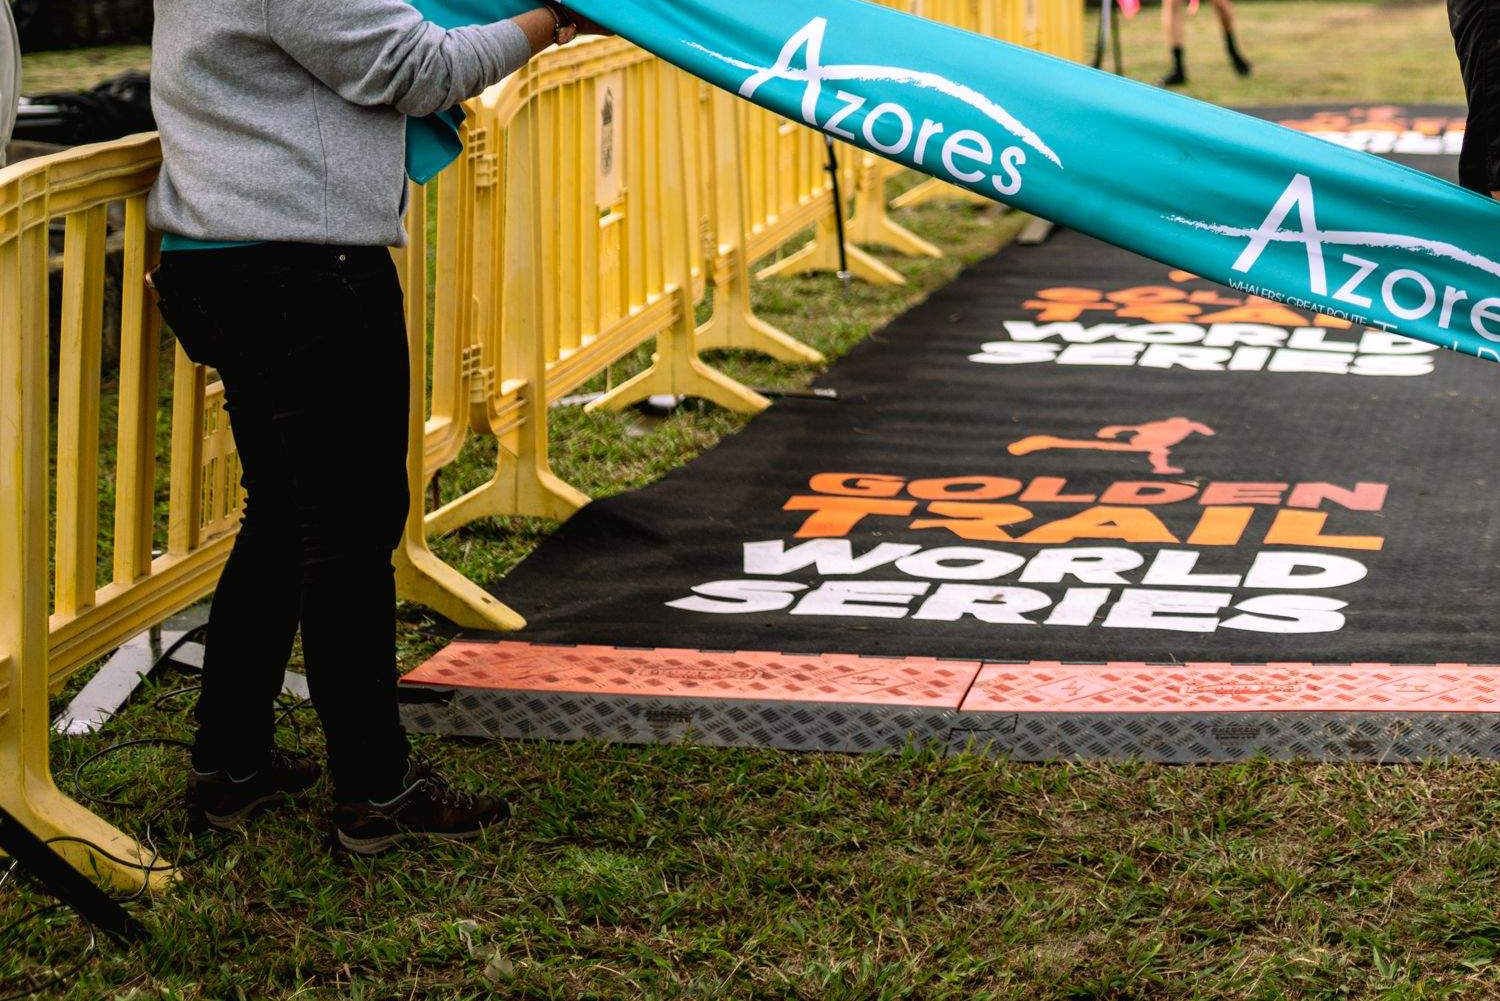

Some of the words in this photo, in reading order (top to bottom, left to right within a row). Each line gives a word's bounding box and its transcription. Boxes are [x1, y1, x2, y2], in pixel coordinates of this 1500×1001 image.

[739, 17, 1026, 197] Azores
[968, 341, 1435, 376] SERIES
[1002, 320, 1441, 354] WORLD
[809, 472, 1390, 511] GOLDEN
[782, 495, 1385, 551] TRAIL
[742, 539, 1368, 589] WORLD
[667, 579, 1350, 633] SERIES
